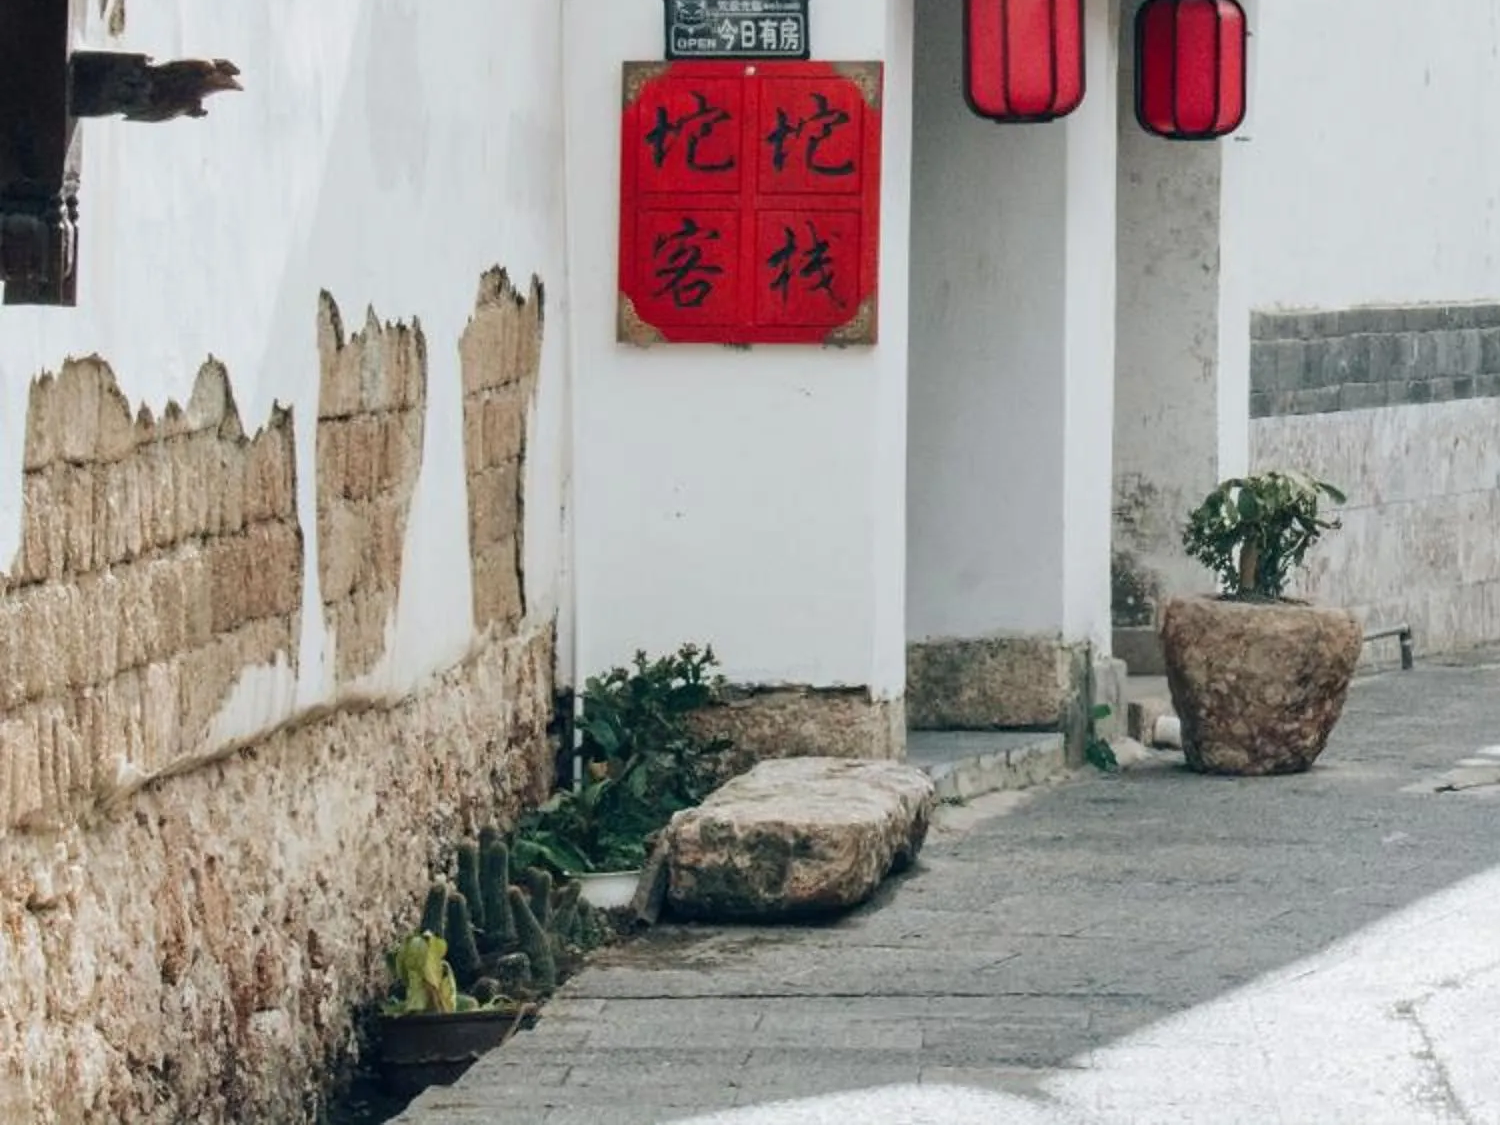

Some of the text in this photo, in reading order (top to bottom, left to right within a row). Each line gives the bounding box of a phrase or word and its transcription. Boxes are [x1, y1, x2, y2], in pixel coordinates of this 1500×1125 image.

[677, 37, 717, 50] OPEN
[718, 18, 800, 51] 今日有房
[652, 217, 847, 310] 客栈
